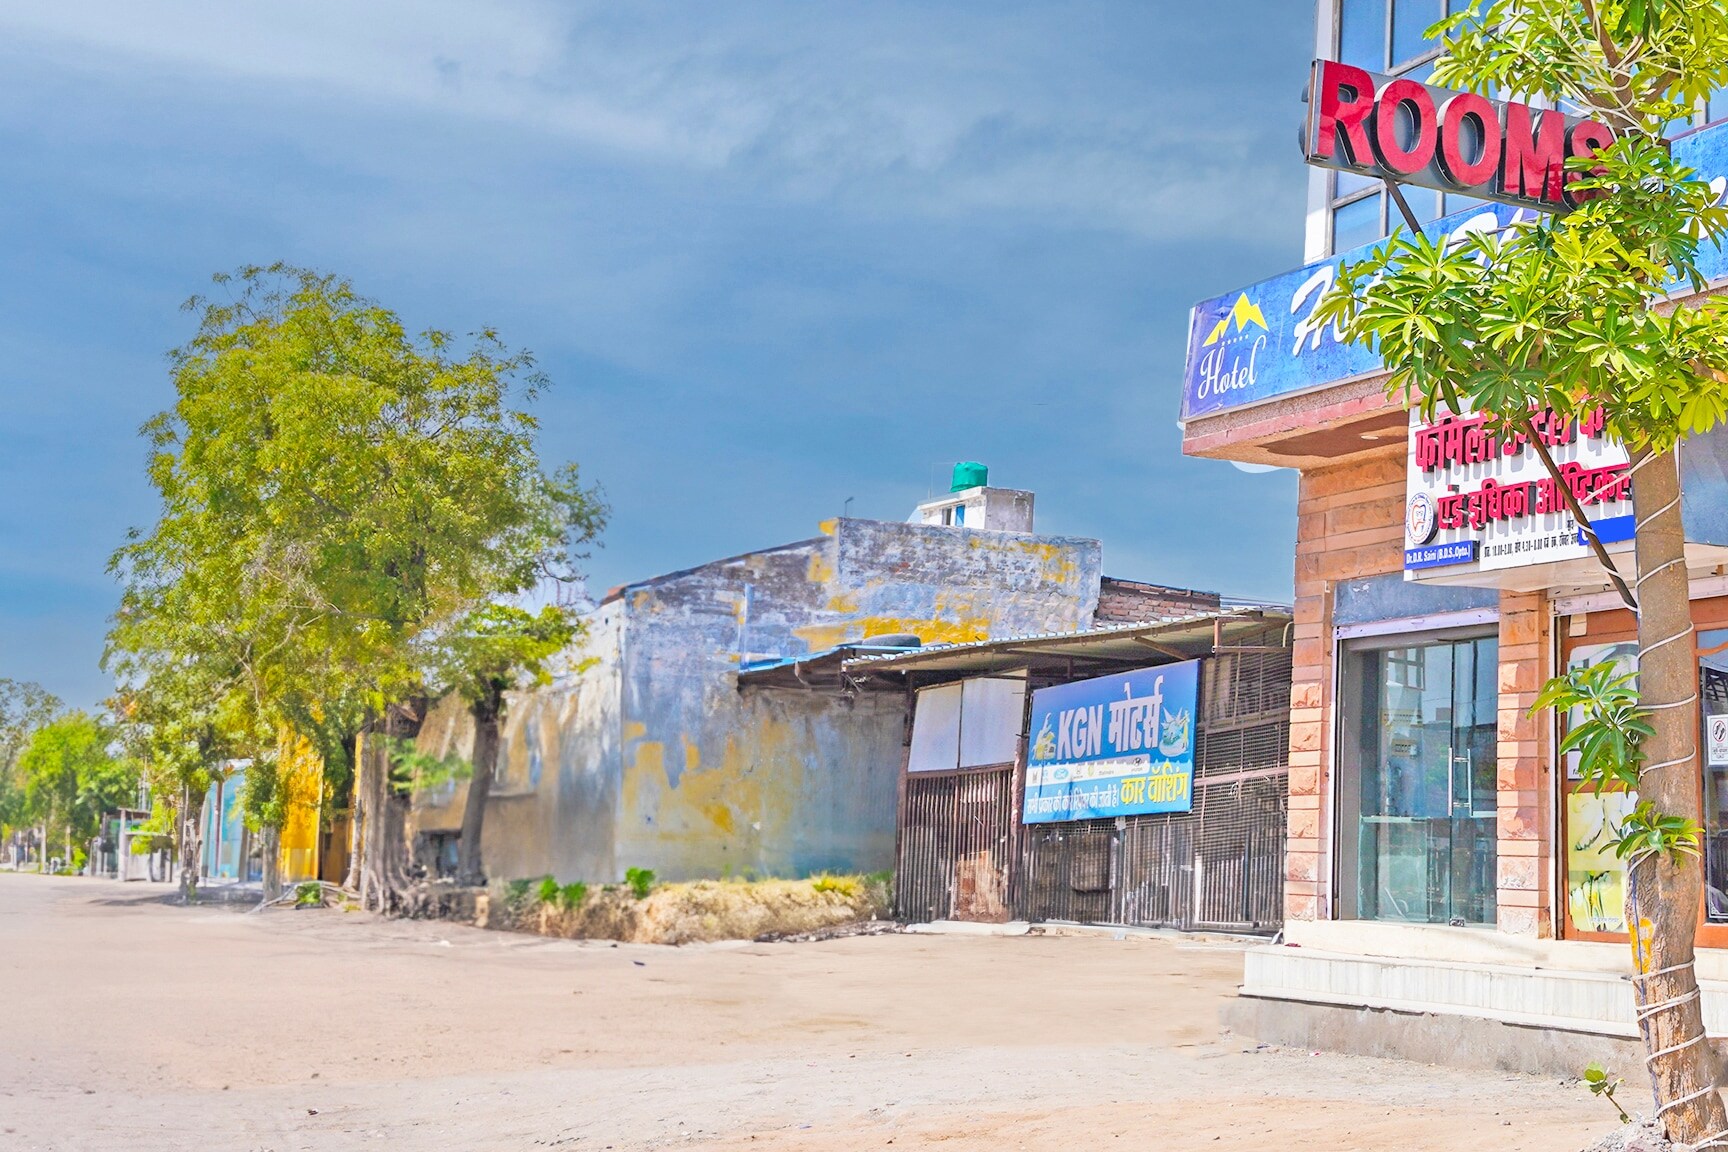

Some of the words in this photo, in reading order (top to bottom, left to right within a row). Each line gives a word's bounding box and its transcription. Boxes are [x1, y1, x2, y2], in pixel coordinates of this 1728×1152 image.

[1316, 60, 1616, 205] ROOMS
[1197, 334, 1267, 400] Hotel
[1056, 703, 1104, 761] KGN
[1108, 675, 1164, 753] मोटर्स
[1120, 776, 1147, 805] कार
